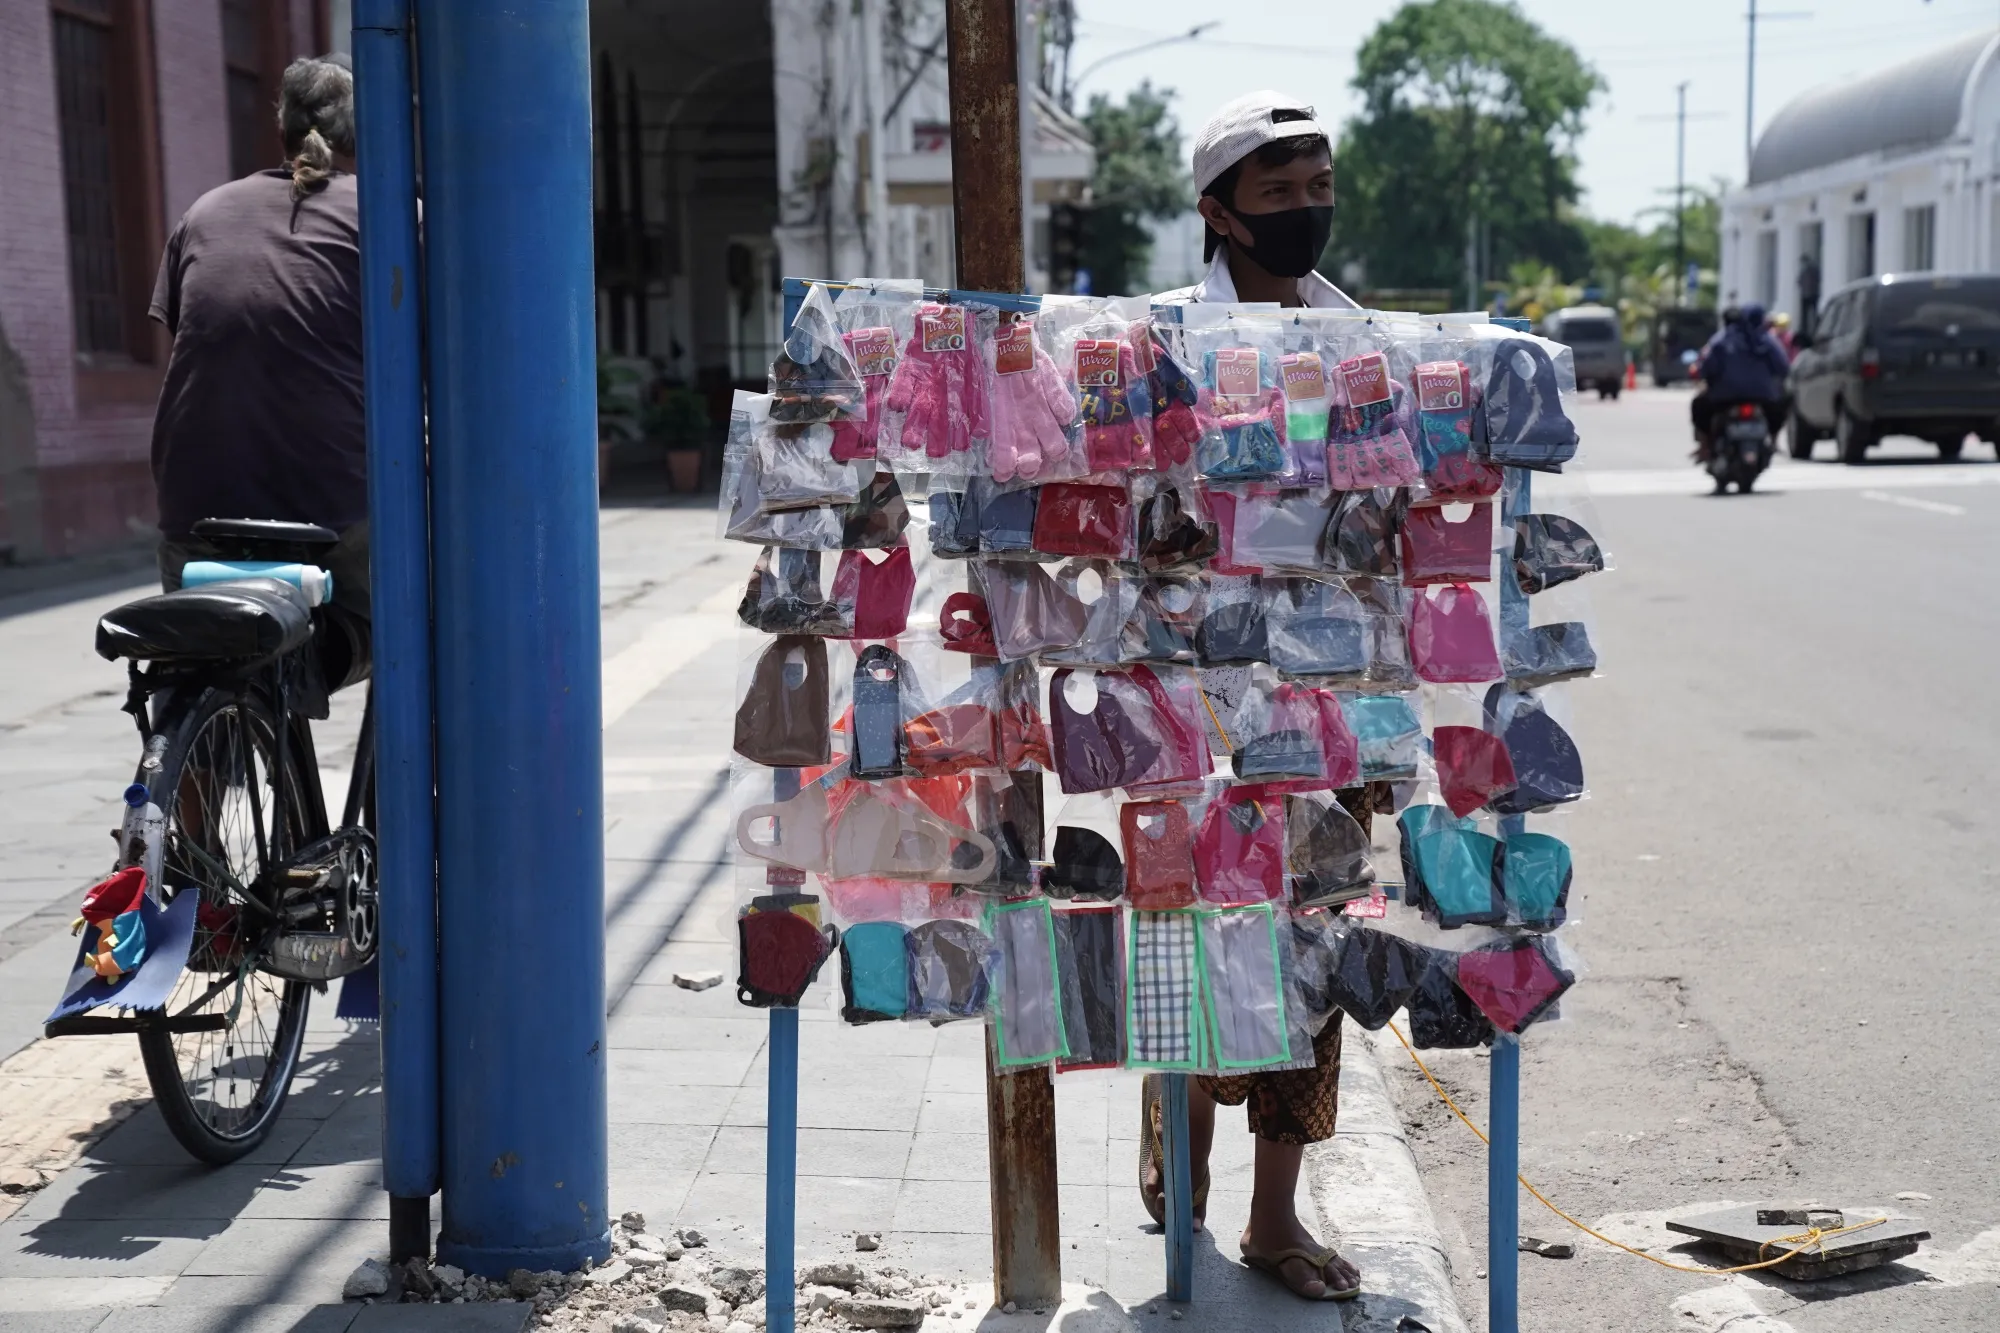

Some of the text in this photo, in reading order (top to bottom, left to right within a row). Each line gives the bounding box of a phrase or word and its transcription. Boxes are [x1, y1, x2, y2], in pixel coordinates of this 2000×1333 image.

[927, 321, 959, 333] Wooll
[858, 343, 891, 357] Wooll
[998, 343, 1029, 356] Wooll
[1080, 354, 1114, 367] Wooll
[1221, 364, 1255, 377] Wooll
[1286, 370, 1320, 384] Wooll
[1349, 372, 1382, 388] Wooll
[1424, 377, 1456, 390] Wooll
